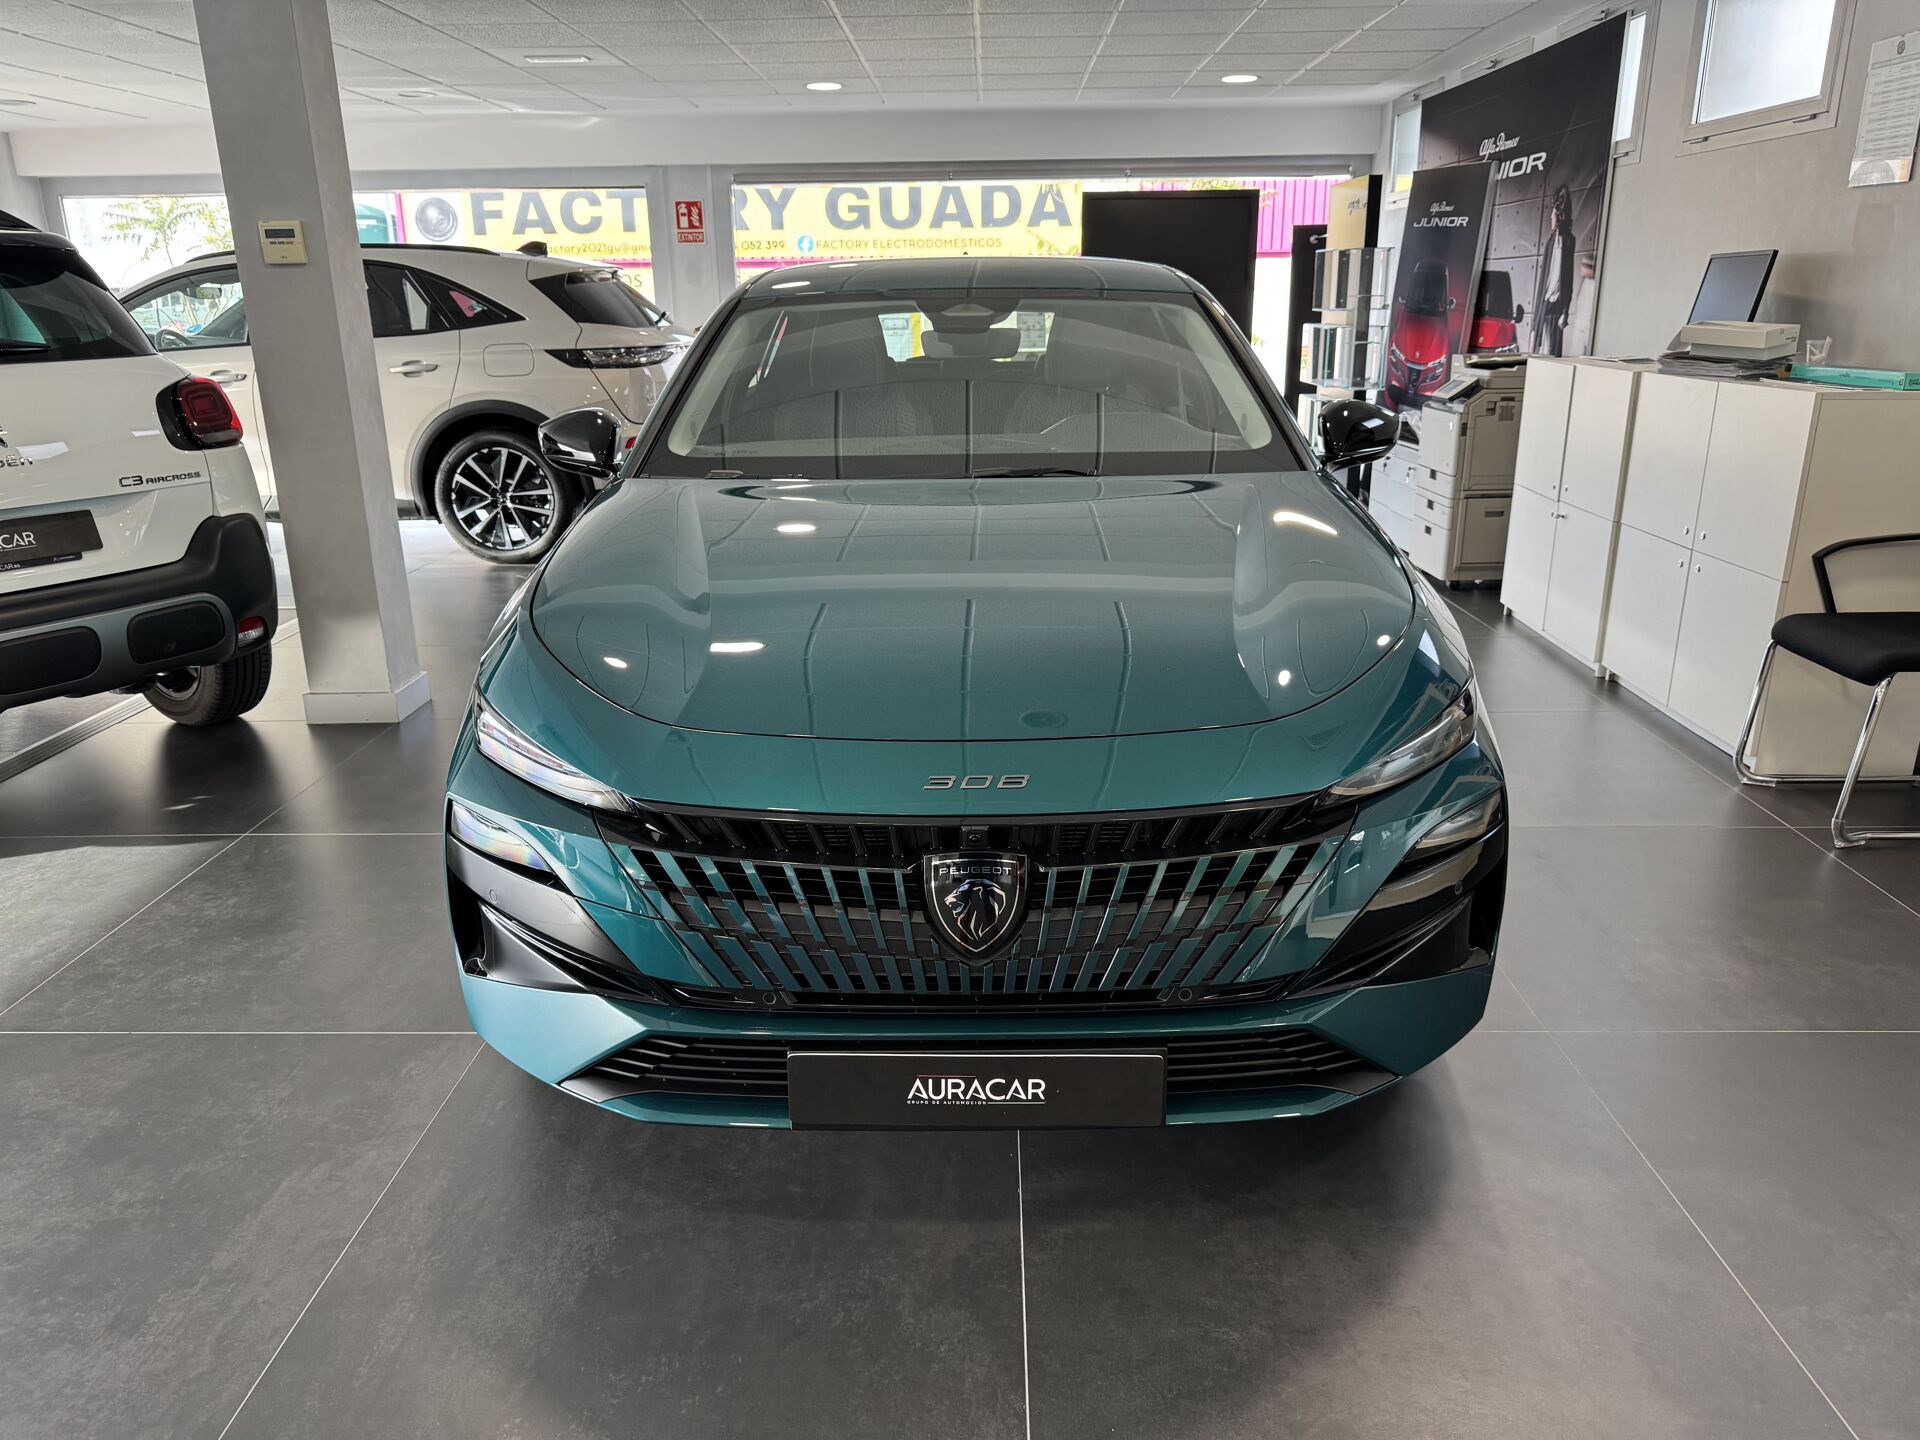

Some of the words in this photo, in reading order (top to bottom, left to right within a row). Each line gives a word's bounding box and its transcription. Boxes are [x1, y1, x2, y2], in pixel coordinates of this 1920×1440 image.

[825, 184, 1072, 231] GUADA
[1413, 216, 1469, 228] JUNIOR
[678, 232, 704, 242] EXTINTOR
[816, 239, 869, 249] FACTORY
[766, 240, 785, 250] 399
[119, 475, 143, 487] C3
[145, 471, 201, 485] AIRCROSS
[0, 531, 36, 549] CAR
[923, 774, 1030, 790] 308
[939, 867, 1012, 876] PEUGEOT
[907, 1078, 1046, 1100] AURACAR
